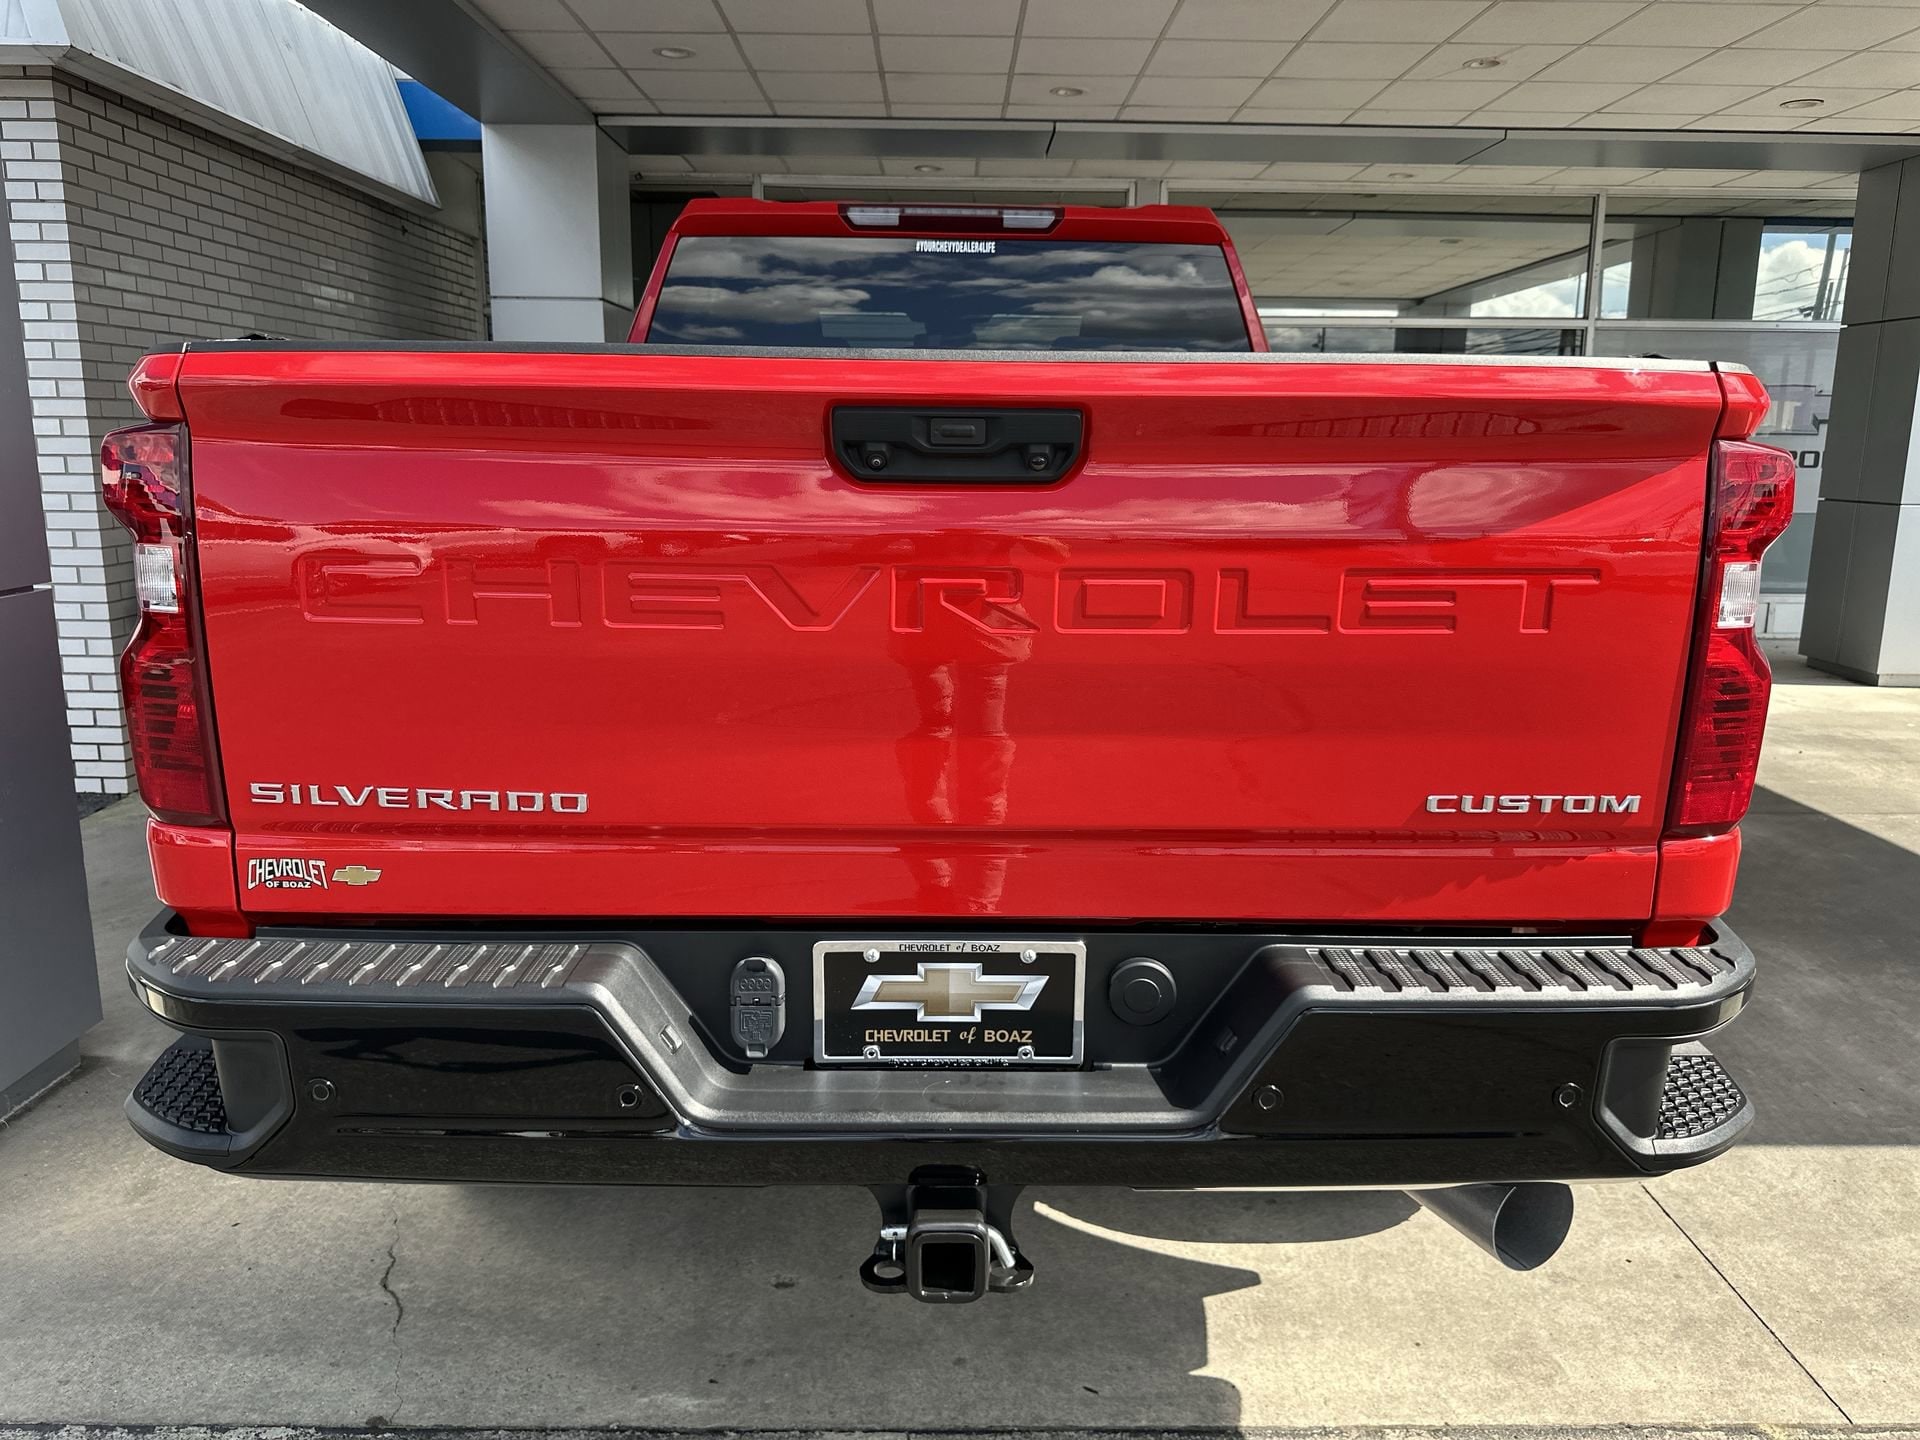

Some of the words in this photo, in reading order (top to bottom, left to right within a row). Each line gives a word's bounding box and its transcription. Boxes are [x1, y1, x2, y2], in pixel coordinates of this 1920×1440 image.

[916, 240, 996, 253] #YOURCHEVYDEALER4LIFE
[300, 554, 1602, 635] CHEVROLET
[250, 782, 589, 814] SILVERADO
[1426, 795, 1641, 813] CUSTOM
[247, 858, 329, 890] CHEVROLET
[265, 880, 280, 889] OF
[282, 880, 312, 889] BOAZ
[899, 943, 951, 952] CHEVROLET
[956, 942, 966, 953] of
[971, 944, 1000, 952] BOAZ
[865, 1029, 951, 1042] CHEVROLET
[959, 1026, 977, 1043] of
[984, 1030, 1033, 1043] BOAZ
